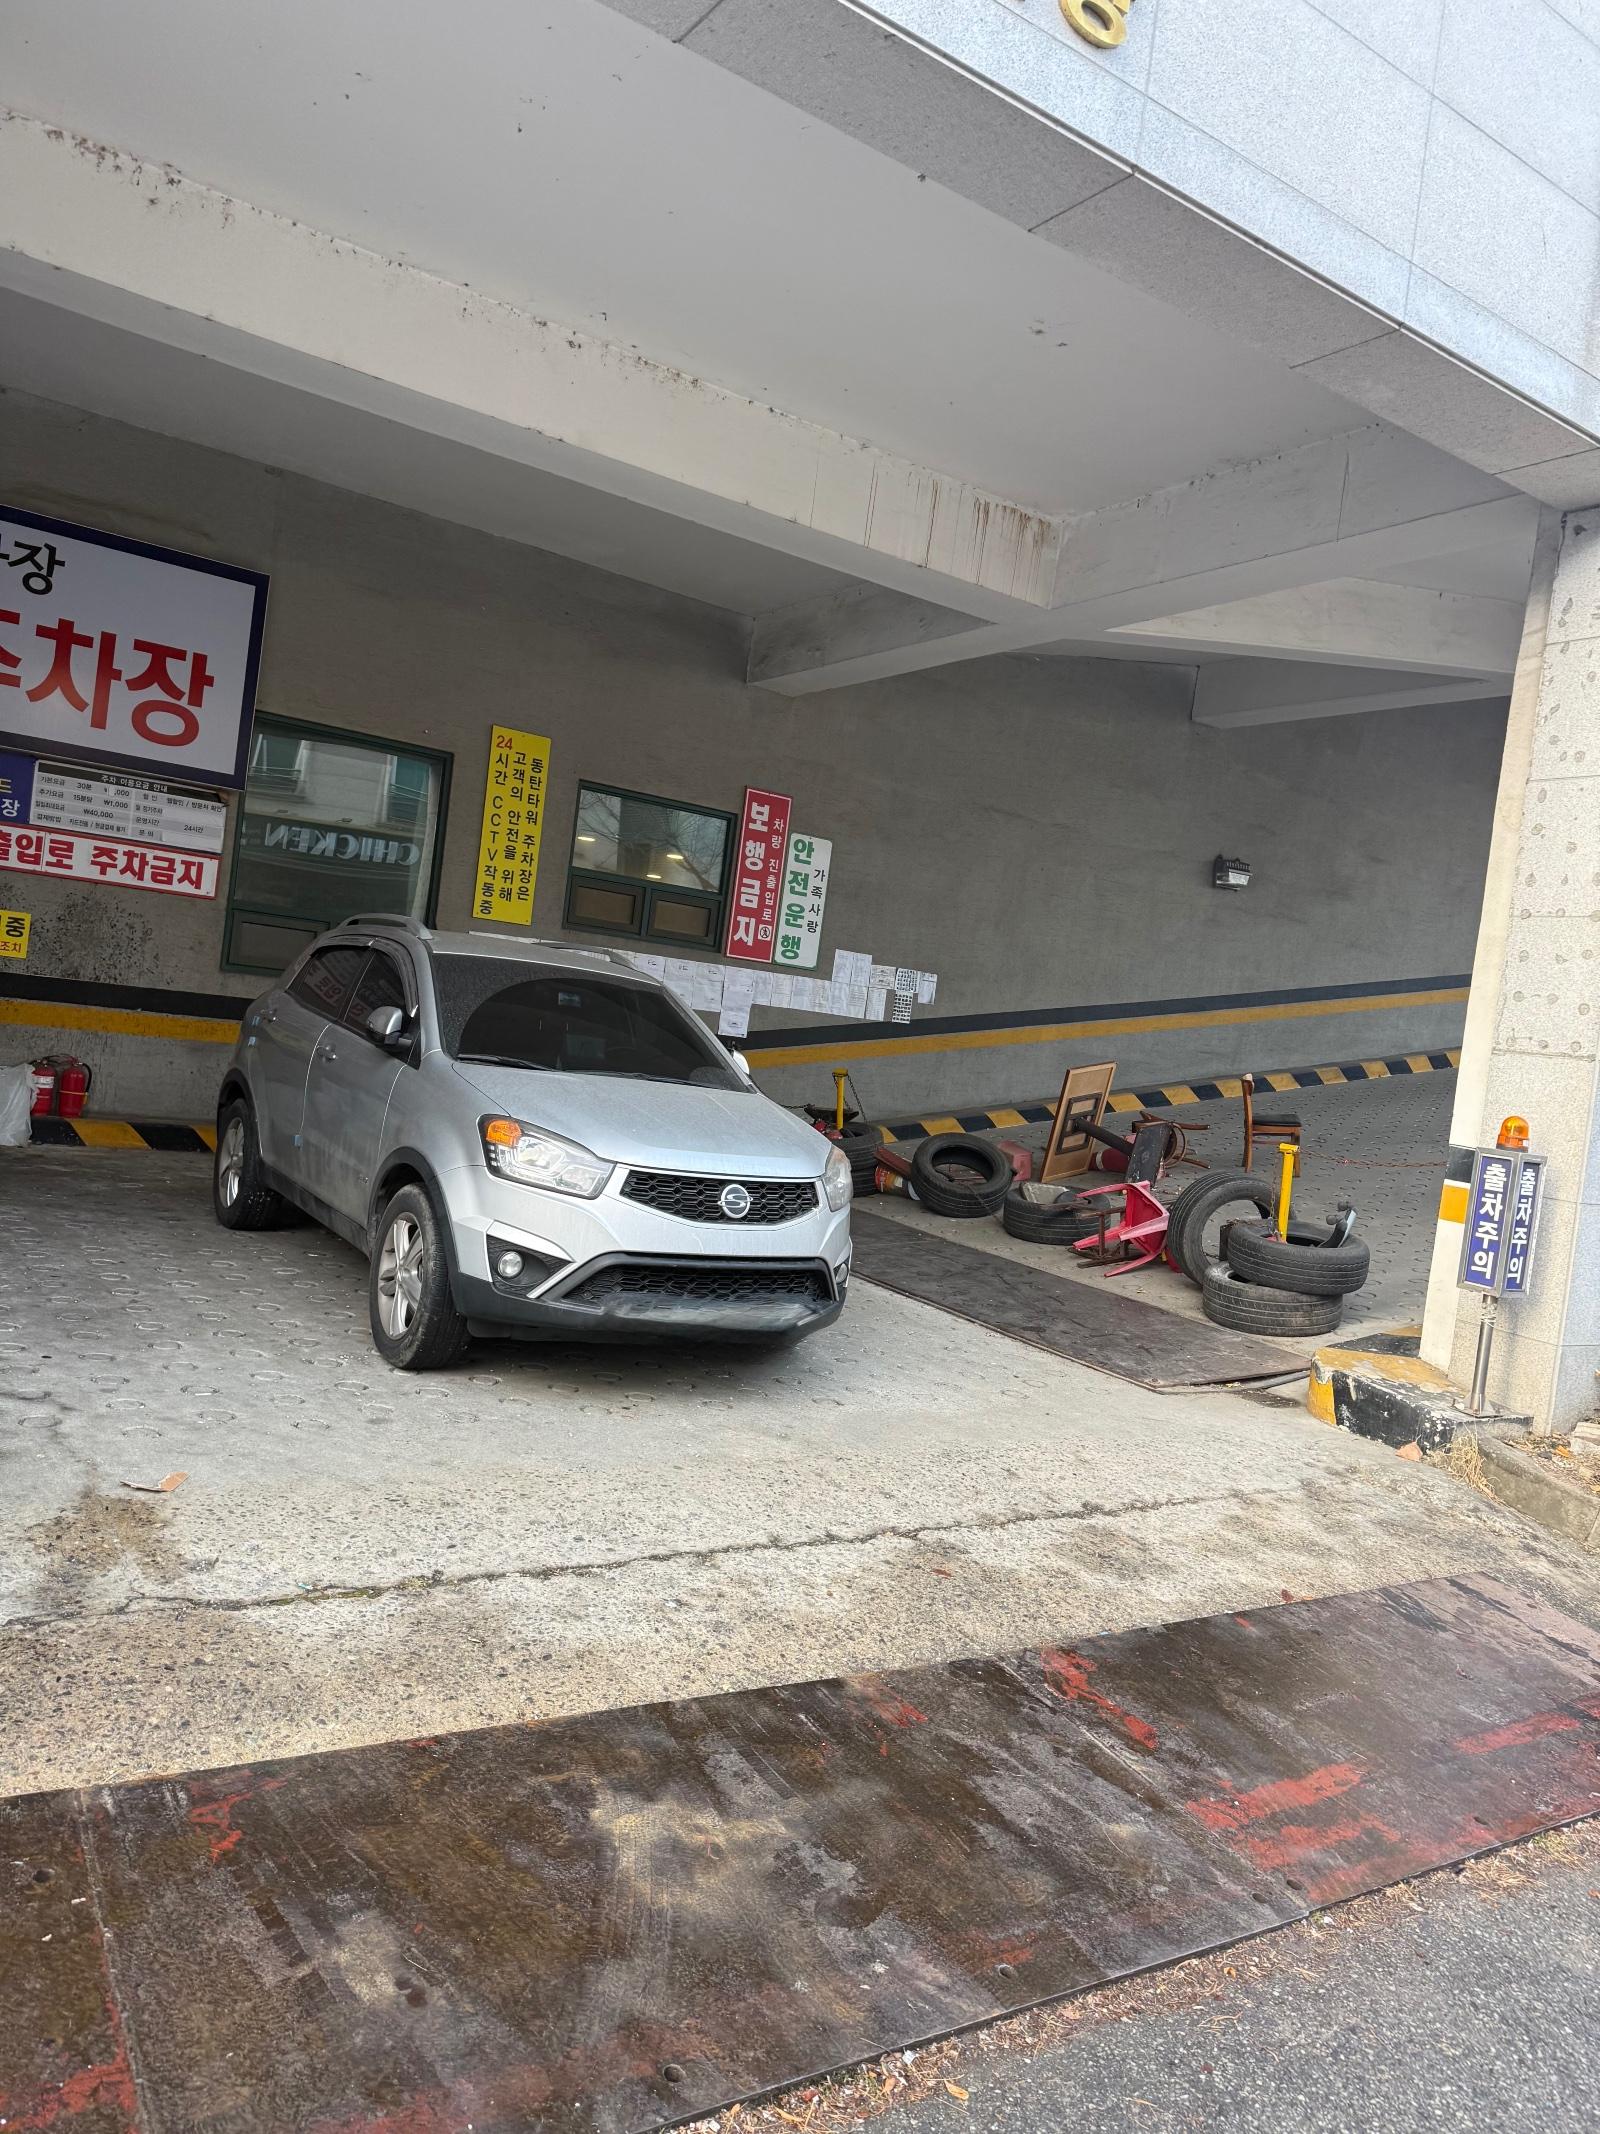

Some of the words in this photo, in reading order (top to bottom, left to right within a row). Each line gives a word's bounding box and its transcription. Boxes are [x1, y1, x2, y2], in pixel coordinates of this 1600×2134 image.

[76, 782, 93, 790] 30분
[510, 751, 527, 802] 고객의
[525, 758, 544, 825] 동탄타워
[504, 809, 521, 860] 안전을
[771, 818, 784, 849] 차량
[90, 845, 204, 890] 주차금지
[499, 869, 515, 902] 위해
[516, 834, 536, 901] 주차장은
[733, 801, 770, 947] 보행금지
[761, 858, 779, 921] 진출입로
[780, 838, 814, 960] 안전운행
[806, 869, 826, 934] 가족사랑
[1471, 1163, 1507, 1279] 출차주의
[1507, 1168, 1536, 1284] 출차주의
